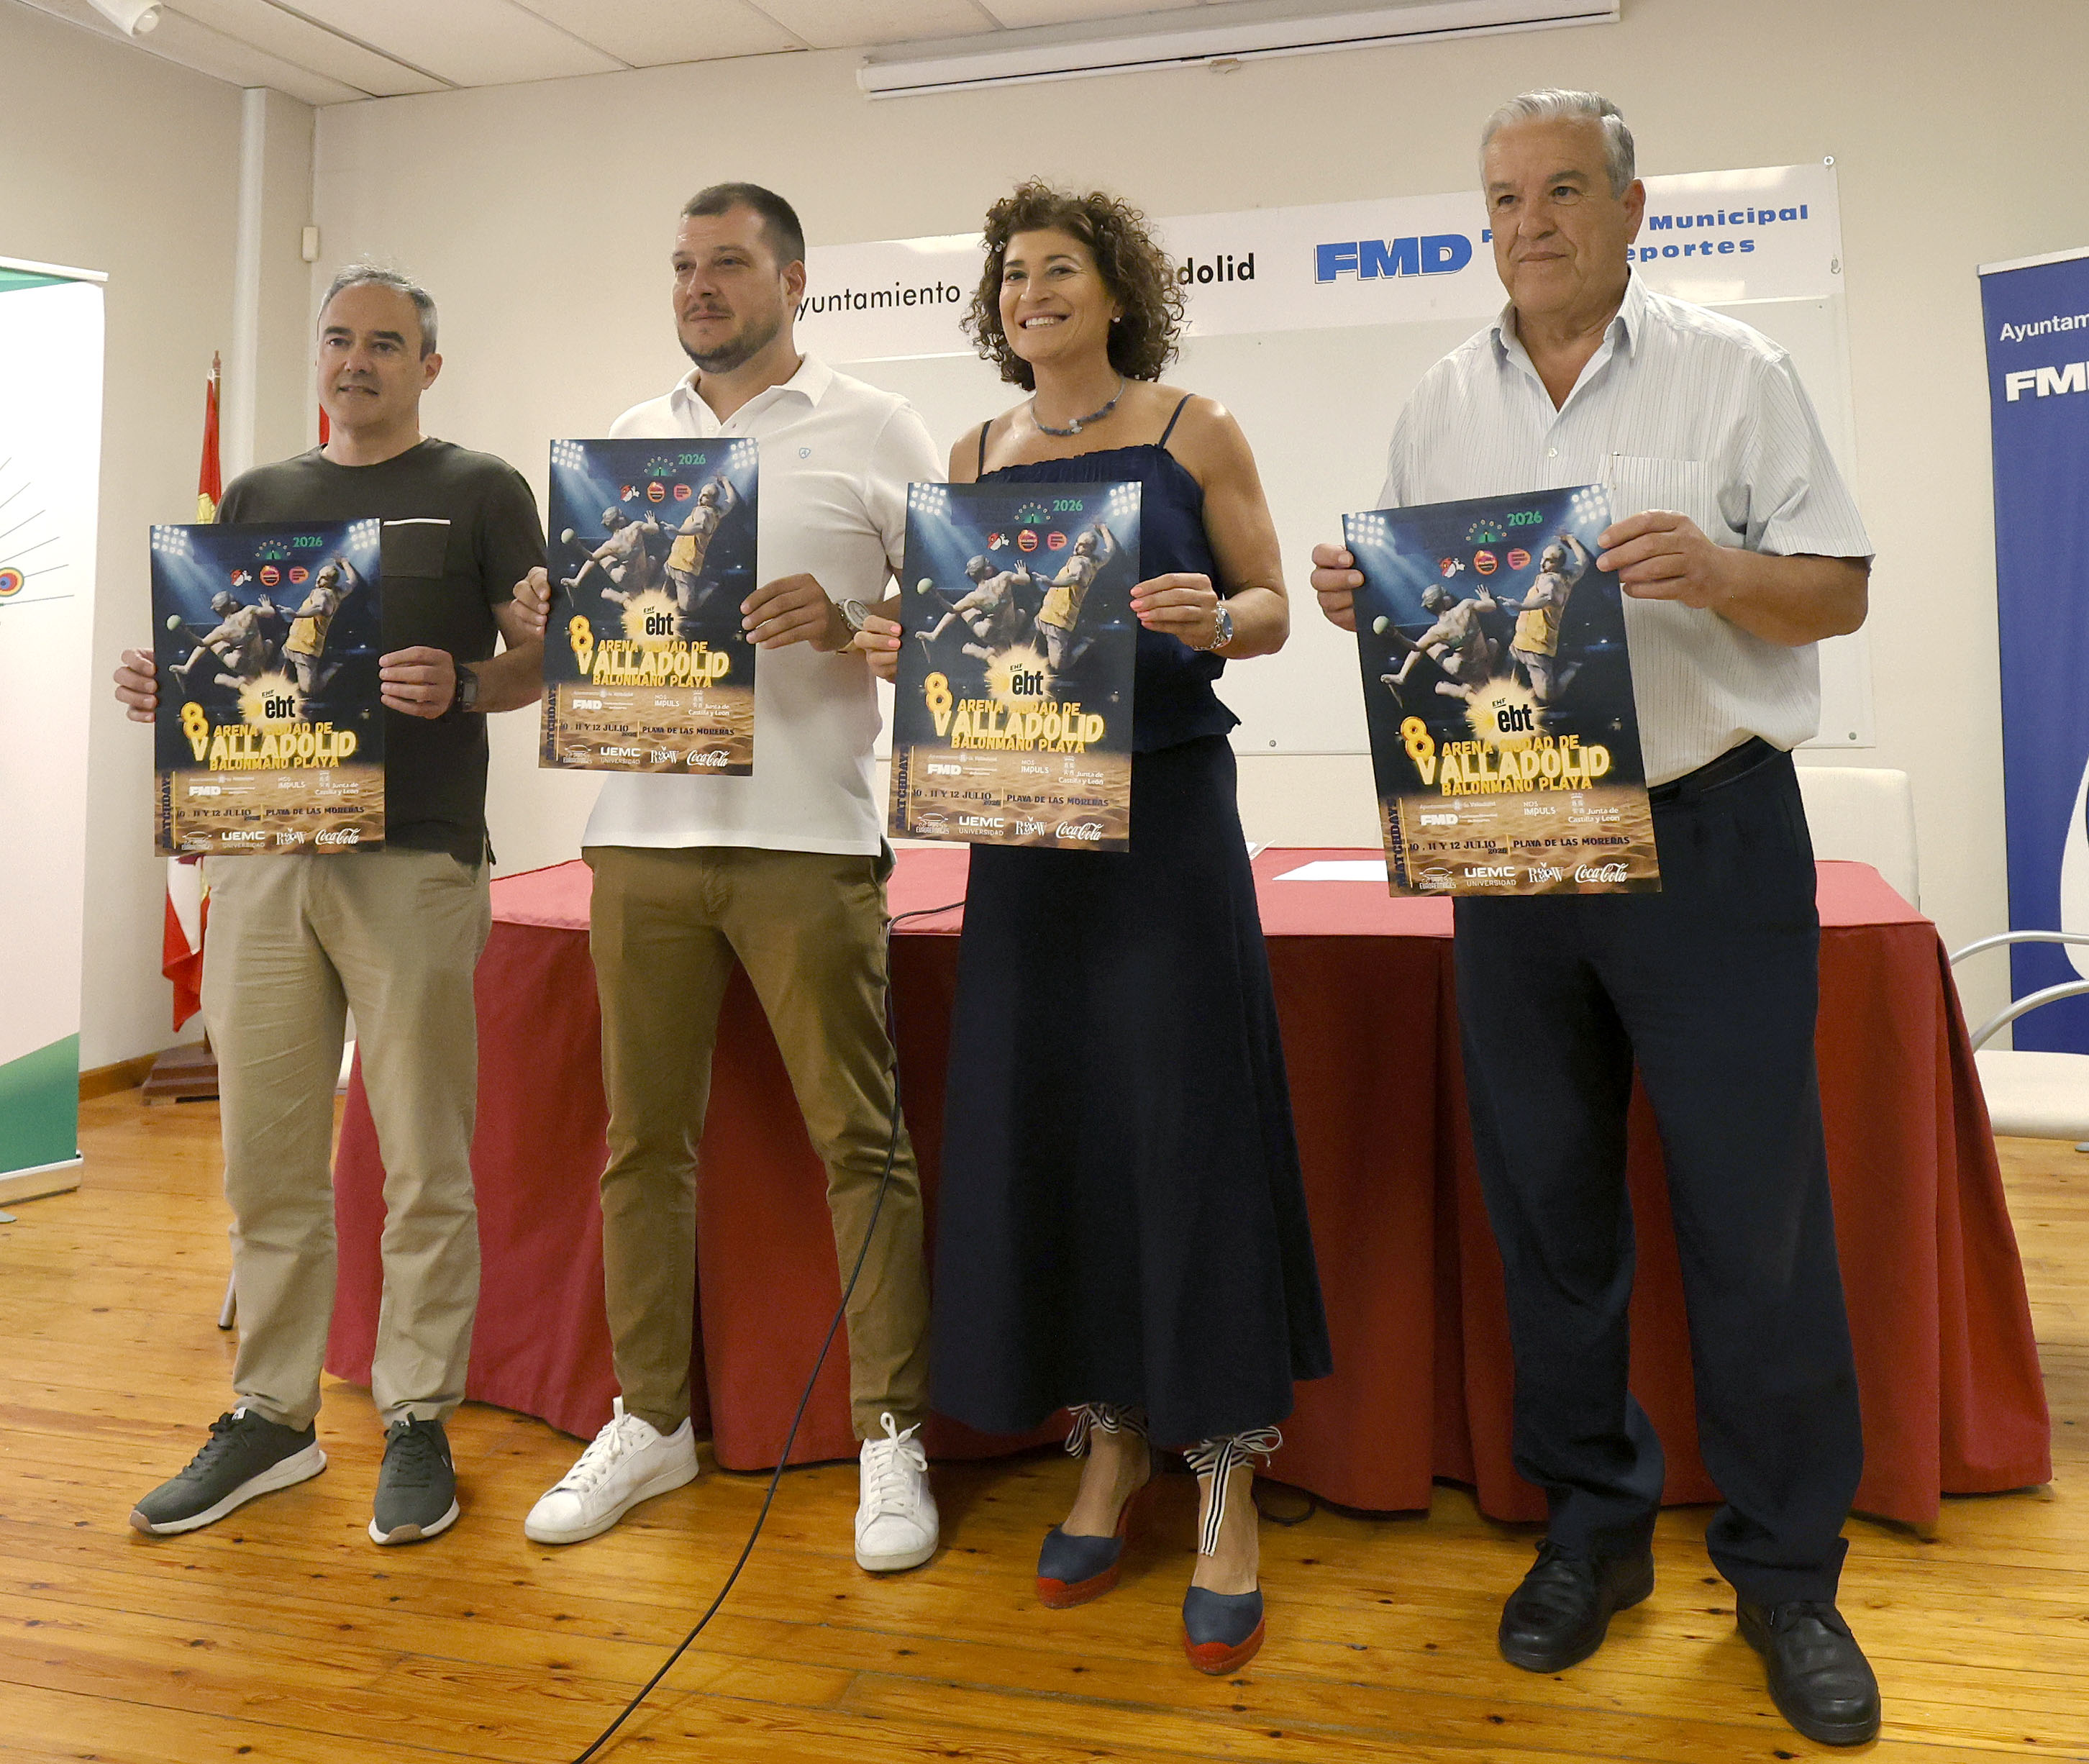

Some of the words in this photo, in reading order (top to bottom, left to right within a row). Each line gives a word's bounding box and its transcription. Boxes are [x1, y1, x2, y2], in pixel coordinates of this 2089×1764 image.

[1649, 204, 1808, 231] Municipal
[1314, 234, 1473, 284] FMD
[1626, 239, 1755, 263] eportes
[798, 281, 961, 322] yuntamiento
[1177, 252, 1255, 285] dolid
[1999, 313, 2089, 342] Ayuntam
[2005, 360, 2089, 402] FM
[678, 453, 706, 463] 2026
[1052, 500, 1084, 512] 2026
[1507, 510, 1544, 527] 2026
[293, 536, 323, 547] 2026
[645, 612, 673, 635] ebt
[569, 615, 594, 653] 8
[598, 640, 638, 652] ARENA
[691, 640, 707, 653] DE
[576, 649, 729, 677] VALLADOLID
[1010, 663, 1023, 671] EHF
[593, 673, 666, 687] BALONMANO
[670, 674, 712, 688] PLAYA
[1012, 670, 1044, 695] ebt
[925, 671, 953, 713] 8
[265, 695, 295, 718] ebt
[572, 699, 603, 709] FMD
[957, 699, 1003, 713] ARENA
[1062, 701, 1081, 716] DE
[1491, 698, 1506, 707] EHF
[181, 701, 209, 740] 8
[932, 708, 1105, 742] VALLADOLID
[1496, 704, 1534, 732] ebt
[213, 724, 258, 737] ARENA
[315, 722, 332, 735] DE
[1401, 716, 1435, 760] 8
[190, 731, 355, 760] VALLADOLID
[601, 746, 641, 757] UEMC
[951, 735, 1034, 752] BALONMANO
[1038, 738, 1086, 754] PLAYA
[1440, 740, 1493, 756] ARENA
[1558, 734, 1580, 750] DE
[209, 758, 289, 771] BALONMANO
[294, 755, 339, 768] PLAYA
[927, 763, 962, 776] FMD
[1416, 745, 1612, 785] VALLADOLID
[187, 786, 221, 796] FMD
[1441, 778, 1534, 796] BALONMANO
[1538, 775, 1593, 791] PLAYA
[962, 791, 991, 800] JULIO
[1006, 794, 1031, 802] PLAYA
[1048, 796, 1063, 804] LAS
[957, 815, 1004, 828] UEMC
[1419, 814, 1459, 826] FMD
[221, 830, 265, 840] UEMC
[958, 827, 1003, 837] UNIVERSIDAD
[1427, 842, 1437, 850] 11
[1449, 841, 1460, 850] 12
[1462, 840, 1496, 850] JULIO
[1513, 839, 1541, 847] PLAYA
[1544, 838, 1557, 847] DE
[1560, 837, 1578, 846] LAS
[1464, 865, 1516, 878] UEMC
